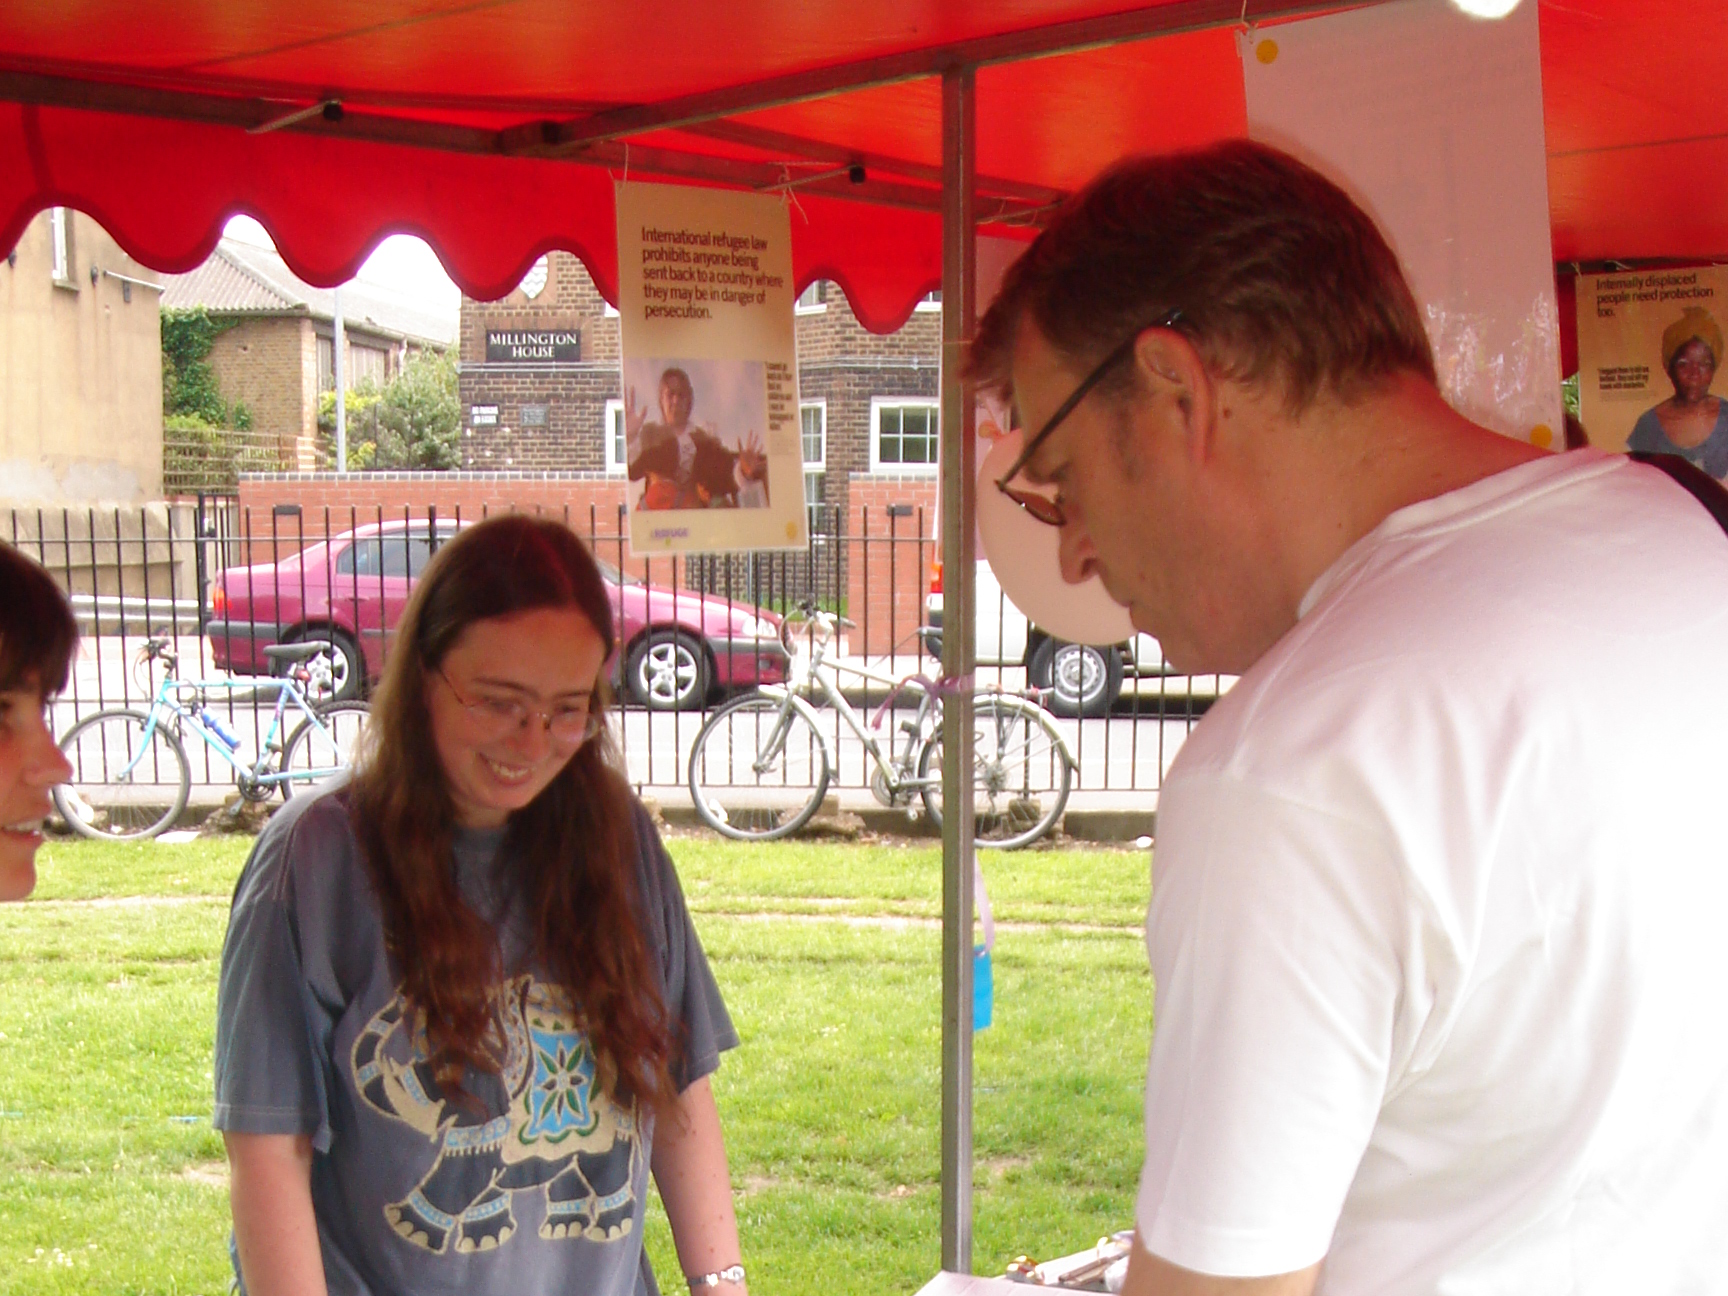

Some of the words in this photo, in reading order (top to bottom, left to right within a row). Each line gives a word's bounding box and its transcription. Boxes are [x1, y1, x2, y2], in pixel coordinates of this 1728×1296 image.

[641, 226, 711, 246] International
[712, 232, 749, 252] refugee
[751, 235, 768, 250] law
[642, 247, 692, 263] prohibits
[693, 252, 730, 268] anyone
[731, 252, 760, 271] being
[643, 265, 668, 280] sent
[669, 265, 697, 281] back
[697, 269, 708, 282] to
[709, 272, 715, 282] a
[717, 271, 754, 288] country
[754, 274, 784, 288] where
[1597, 276, 1643, 290] Internally
[1645, 273, 1697, 289] displaced
[643, 284, 668, 301] they
[670, 287, 694, 303] may
[695, 285, 707, 300] be
[710, 286, 720, 301] in
[721, 288, 755, 306] danger
[756, 290, 766, 304] of
[1597, 292, 1630, 305] people
[1632, 289, 1658, 301] need
[1660, 287, 1714, 302] protection
[645, 303, 713, 320] persecution.
[489, 332, 577, 345] MILLINGTON
[512, 345, 555, 358] HOUSE
